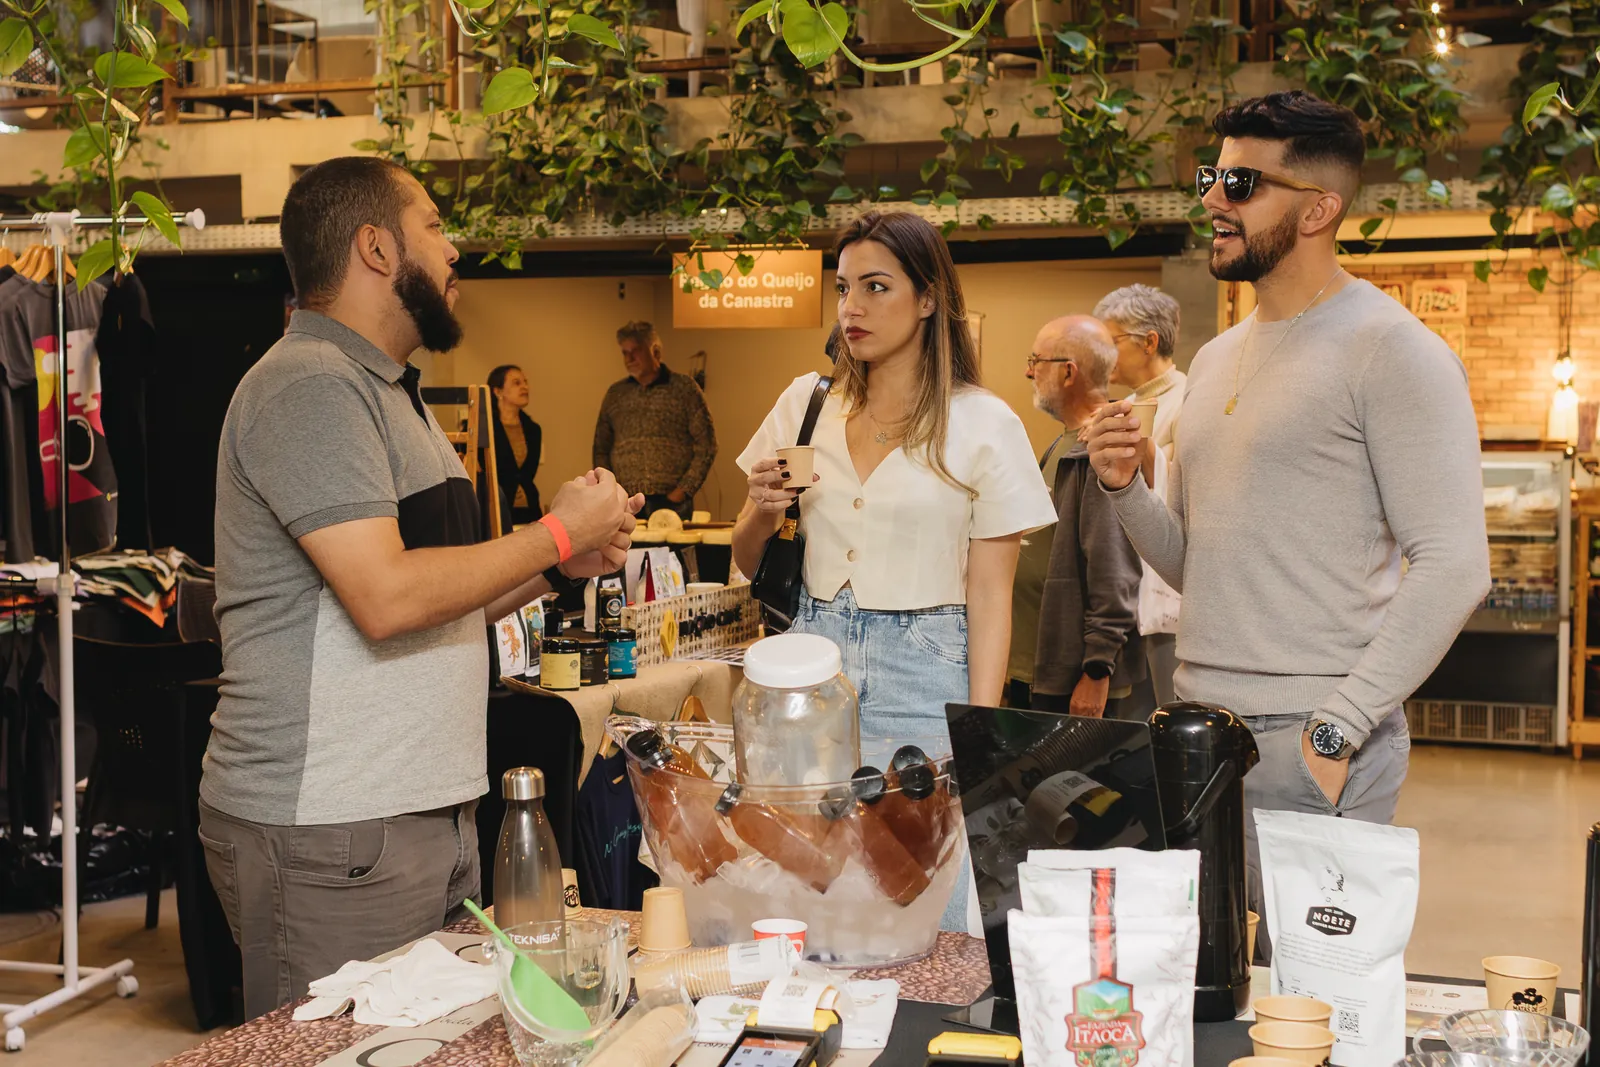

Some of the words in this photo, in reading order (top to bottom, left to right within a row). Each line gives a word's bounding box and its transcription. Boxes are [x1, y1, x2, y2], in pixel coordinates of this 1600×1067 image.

[762, 272, 815, 291] Queijo
[699, 293, 718, 308] da
[722, 293, 794, 308] Canastra
[1312, 911, 1351, 928] NOETE
[508, 932, 559, 945] TEKNISA
[1074, 1024, 1137, 1044] ITAOCA
